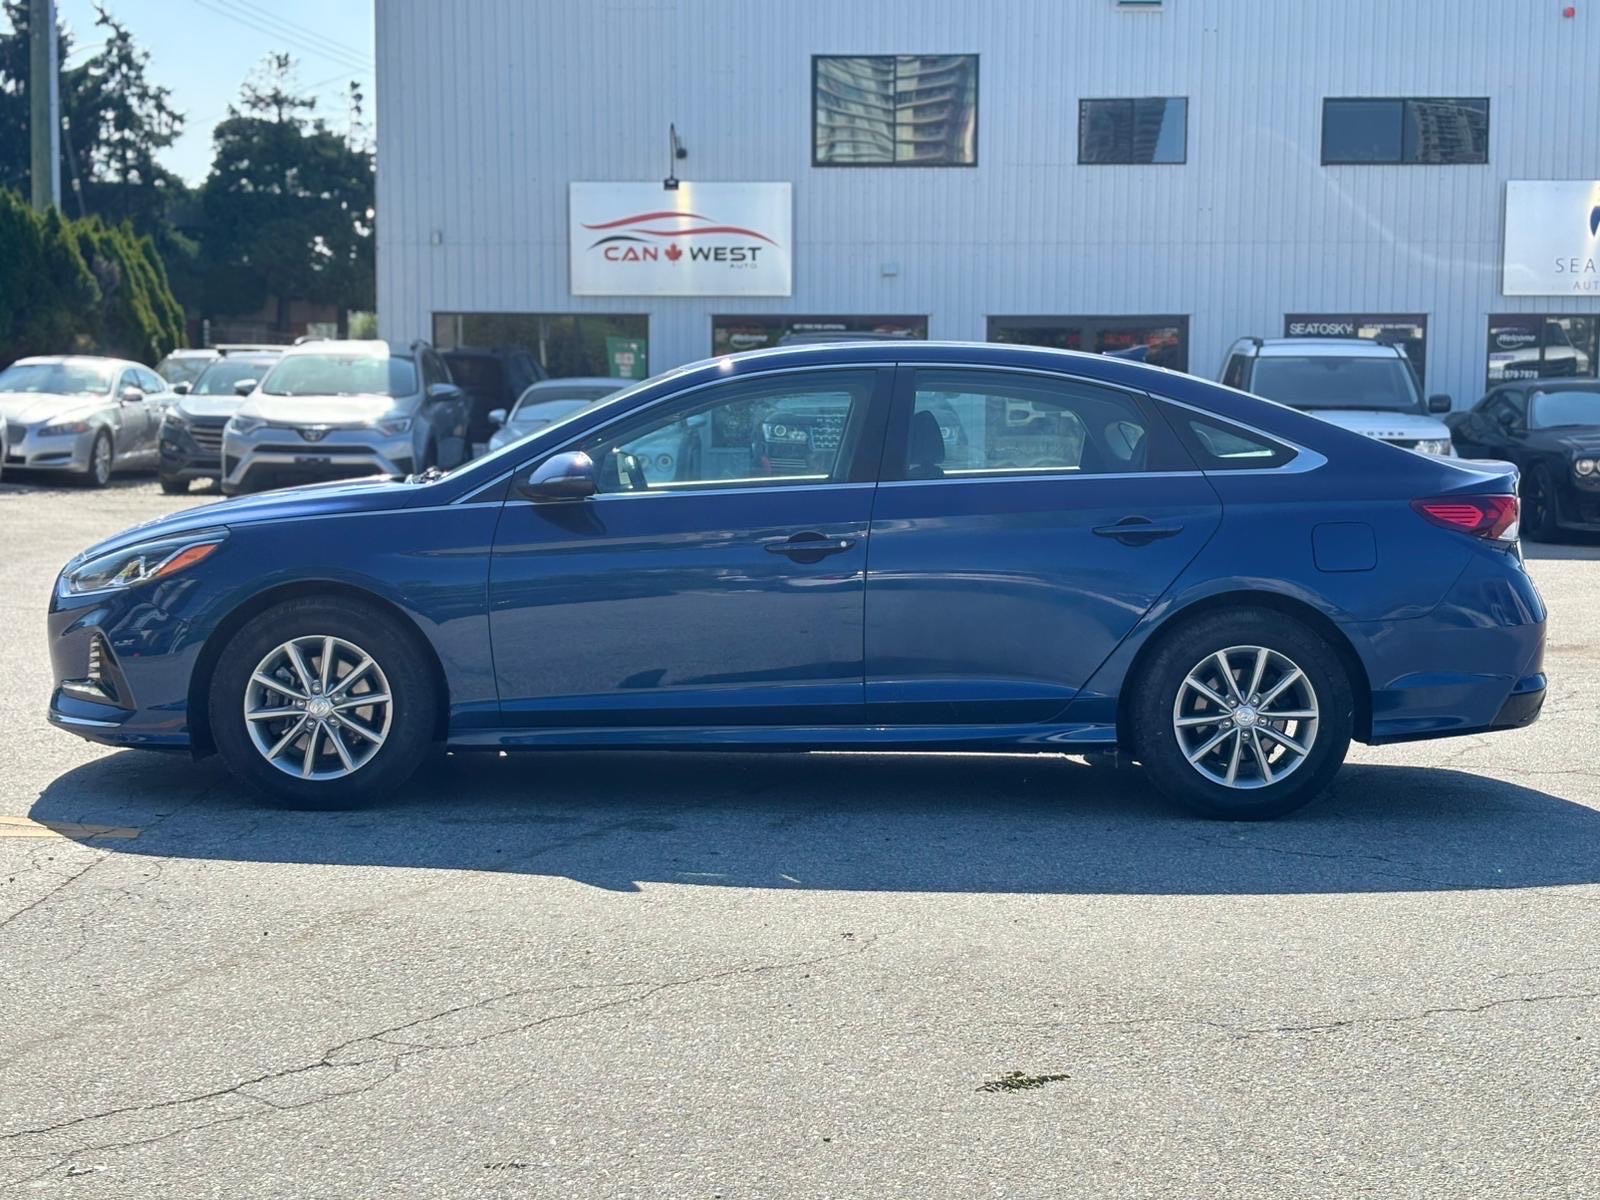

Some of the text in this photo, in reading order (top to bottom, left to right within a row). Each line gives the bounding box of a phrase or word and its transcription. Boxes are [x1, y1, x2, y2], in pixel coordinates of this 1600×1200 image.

[604, 246, 763, 262] CAN WEST
[1554, 257, 1597, 273] SEA
[1289, 322, 1354, 335] SEATOSKY
